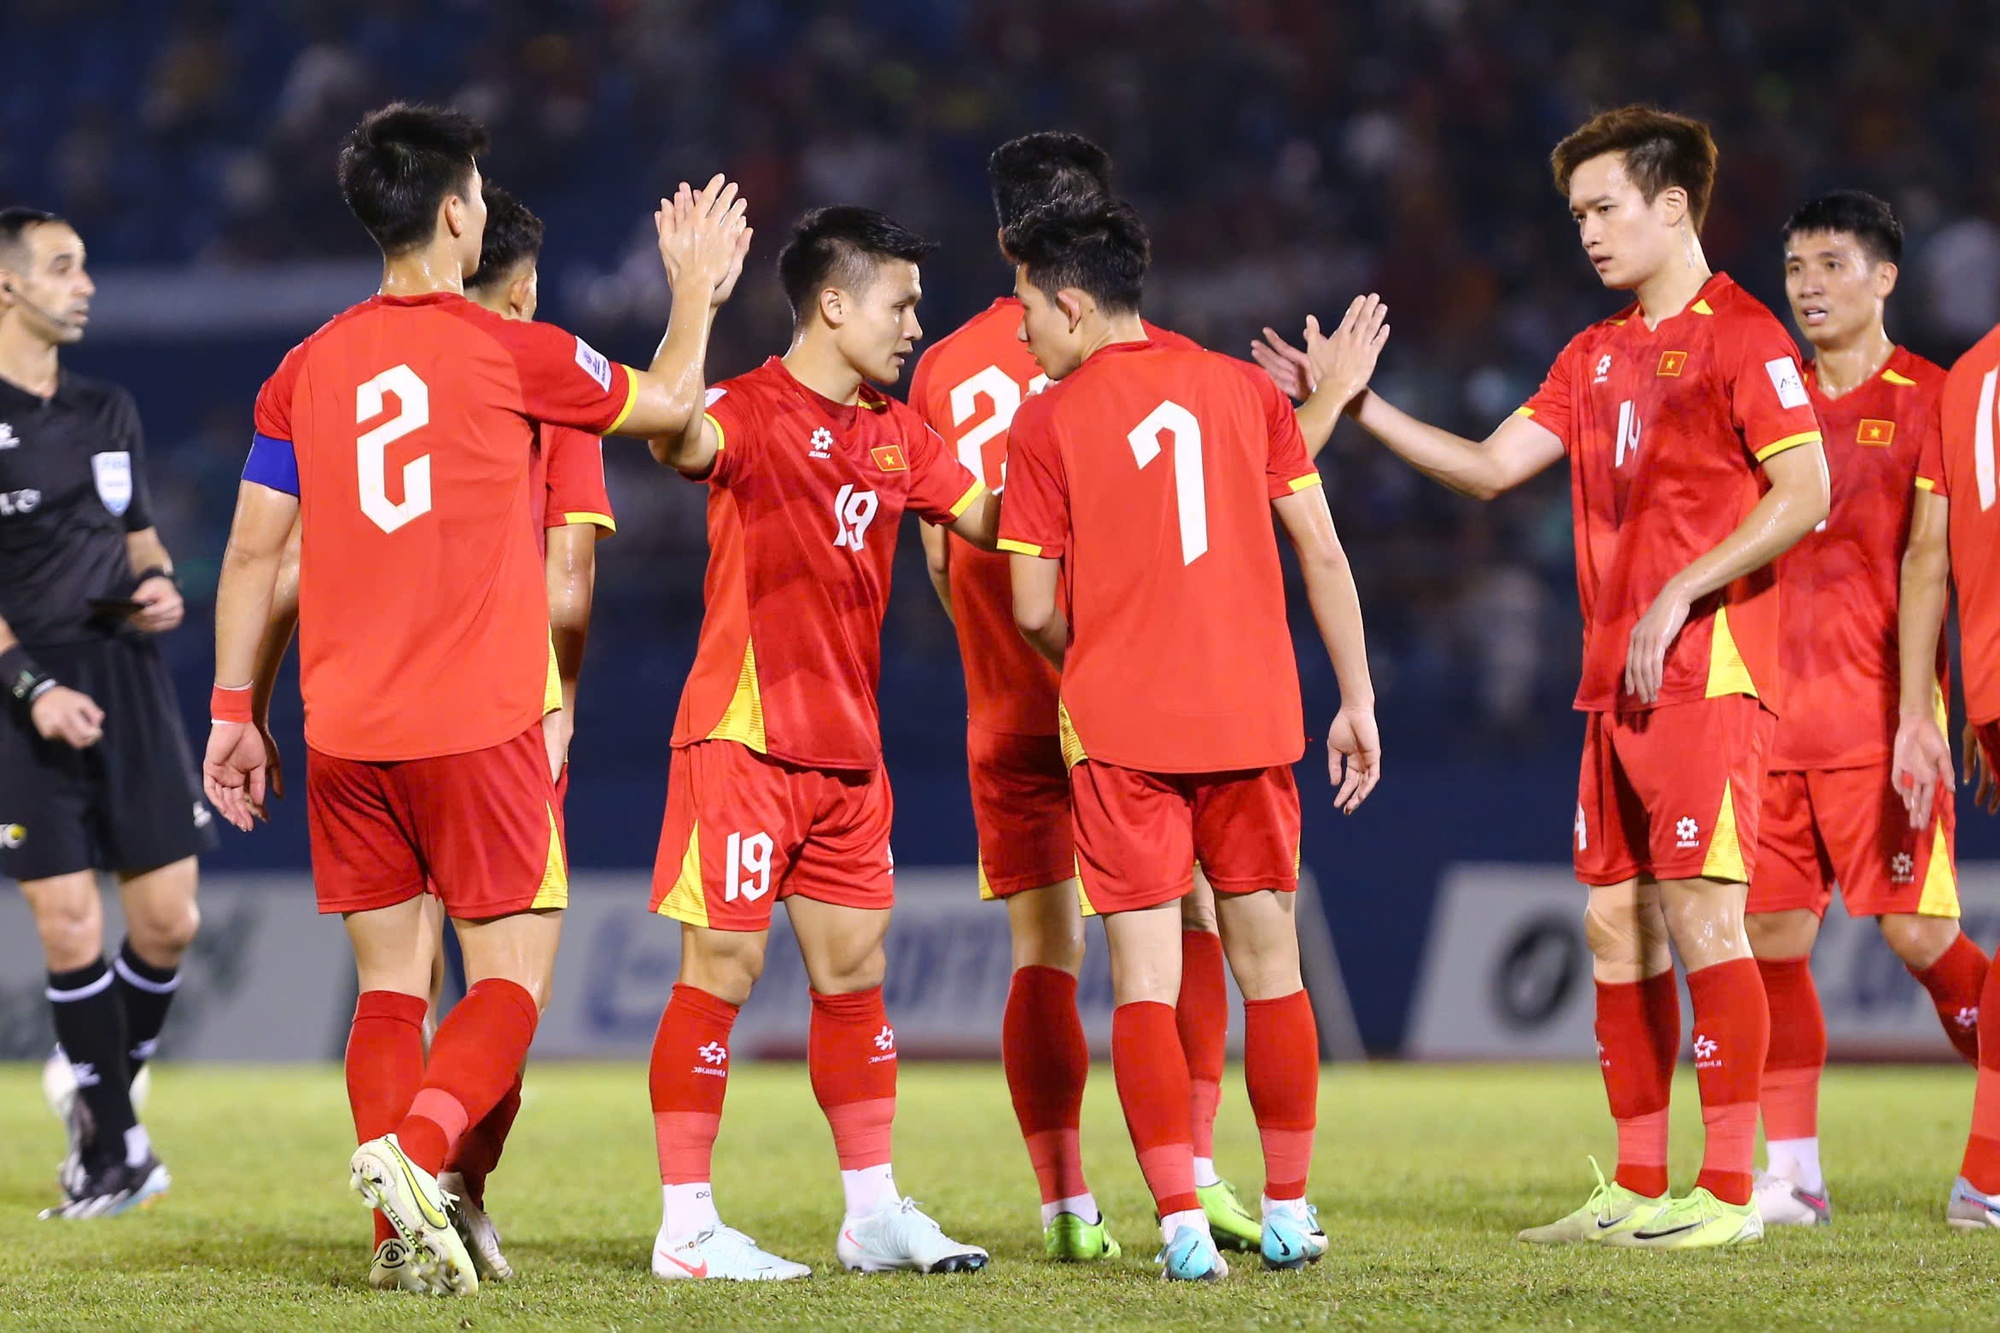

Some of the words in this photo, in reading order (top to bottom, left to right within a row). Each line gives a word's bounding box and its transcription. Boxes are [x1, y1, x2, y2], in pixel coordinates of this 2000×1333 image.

[356, 363, 432, 535] 2
[1615, 399, 1642, 469] 14
[832, 483, 879, 553] 19
[1127, 399, 1209, 567] 7
[725, 831, 774, 902] 19
